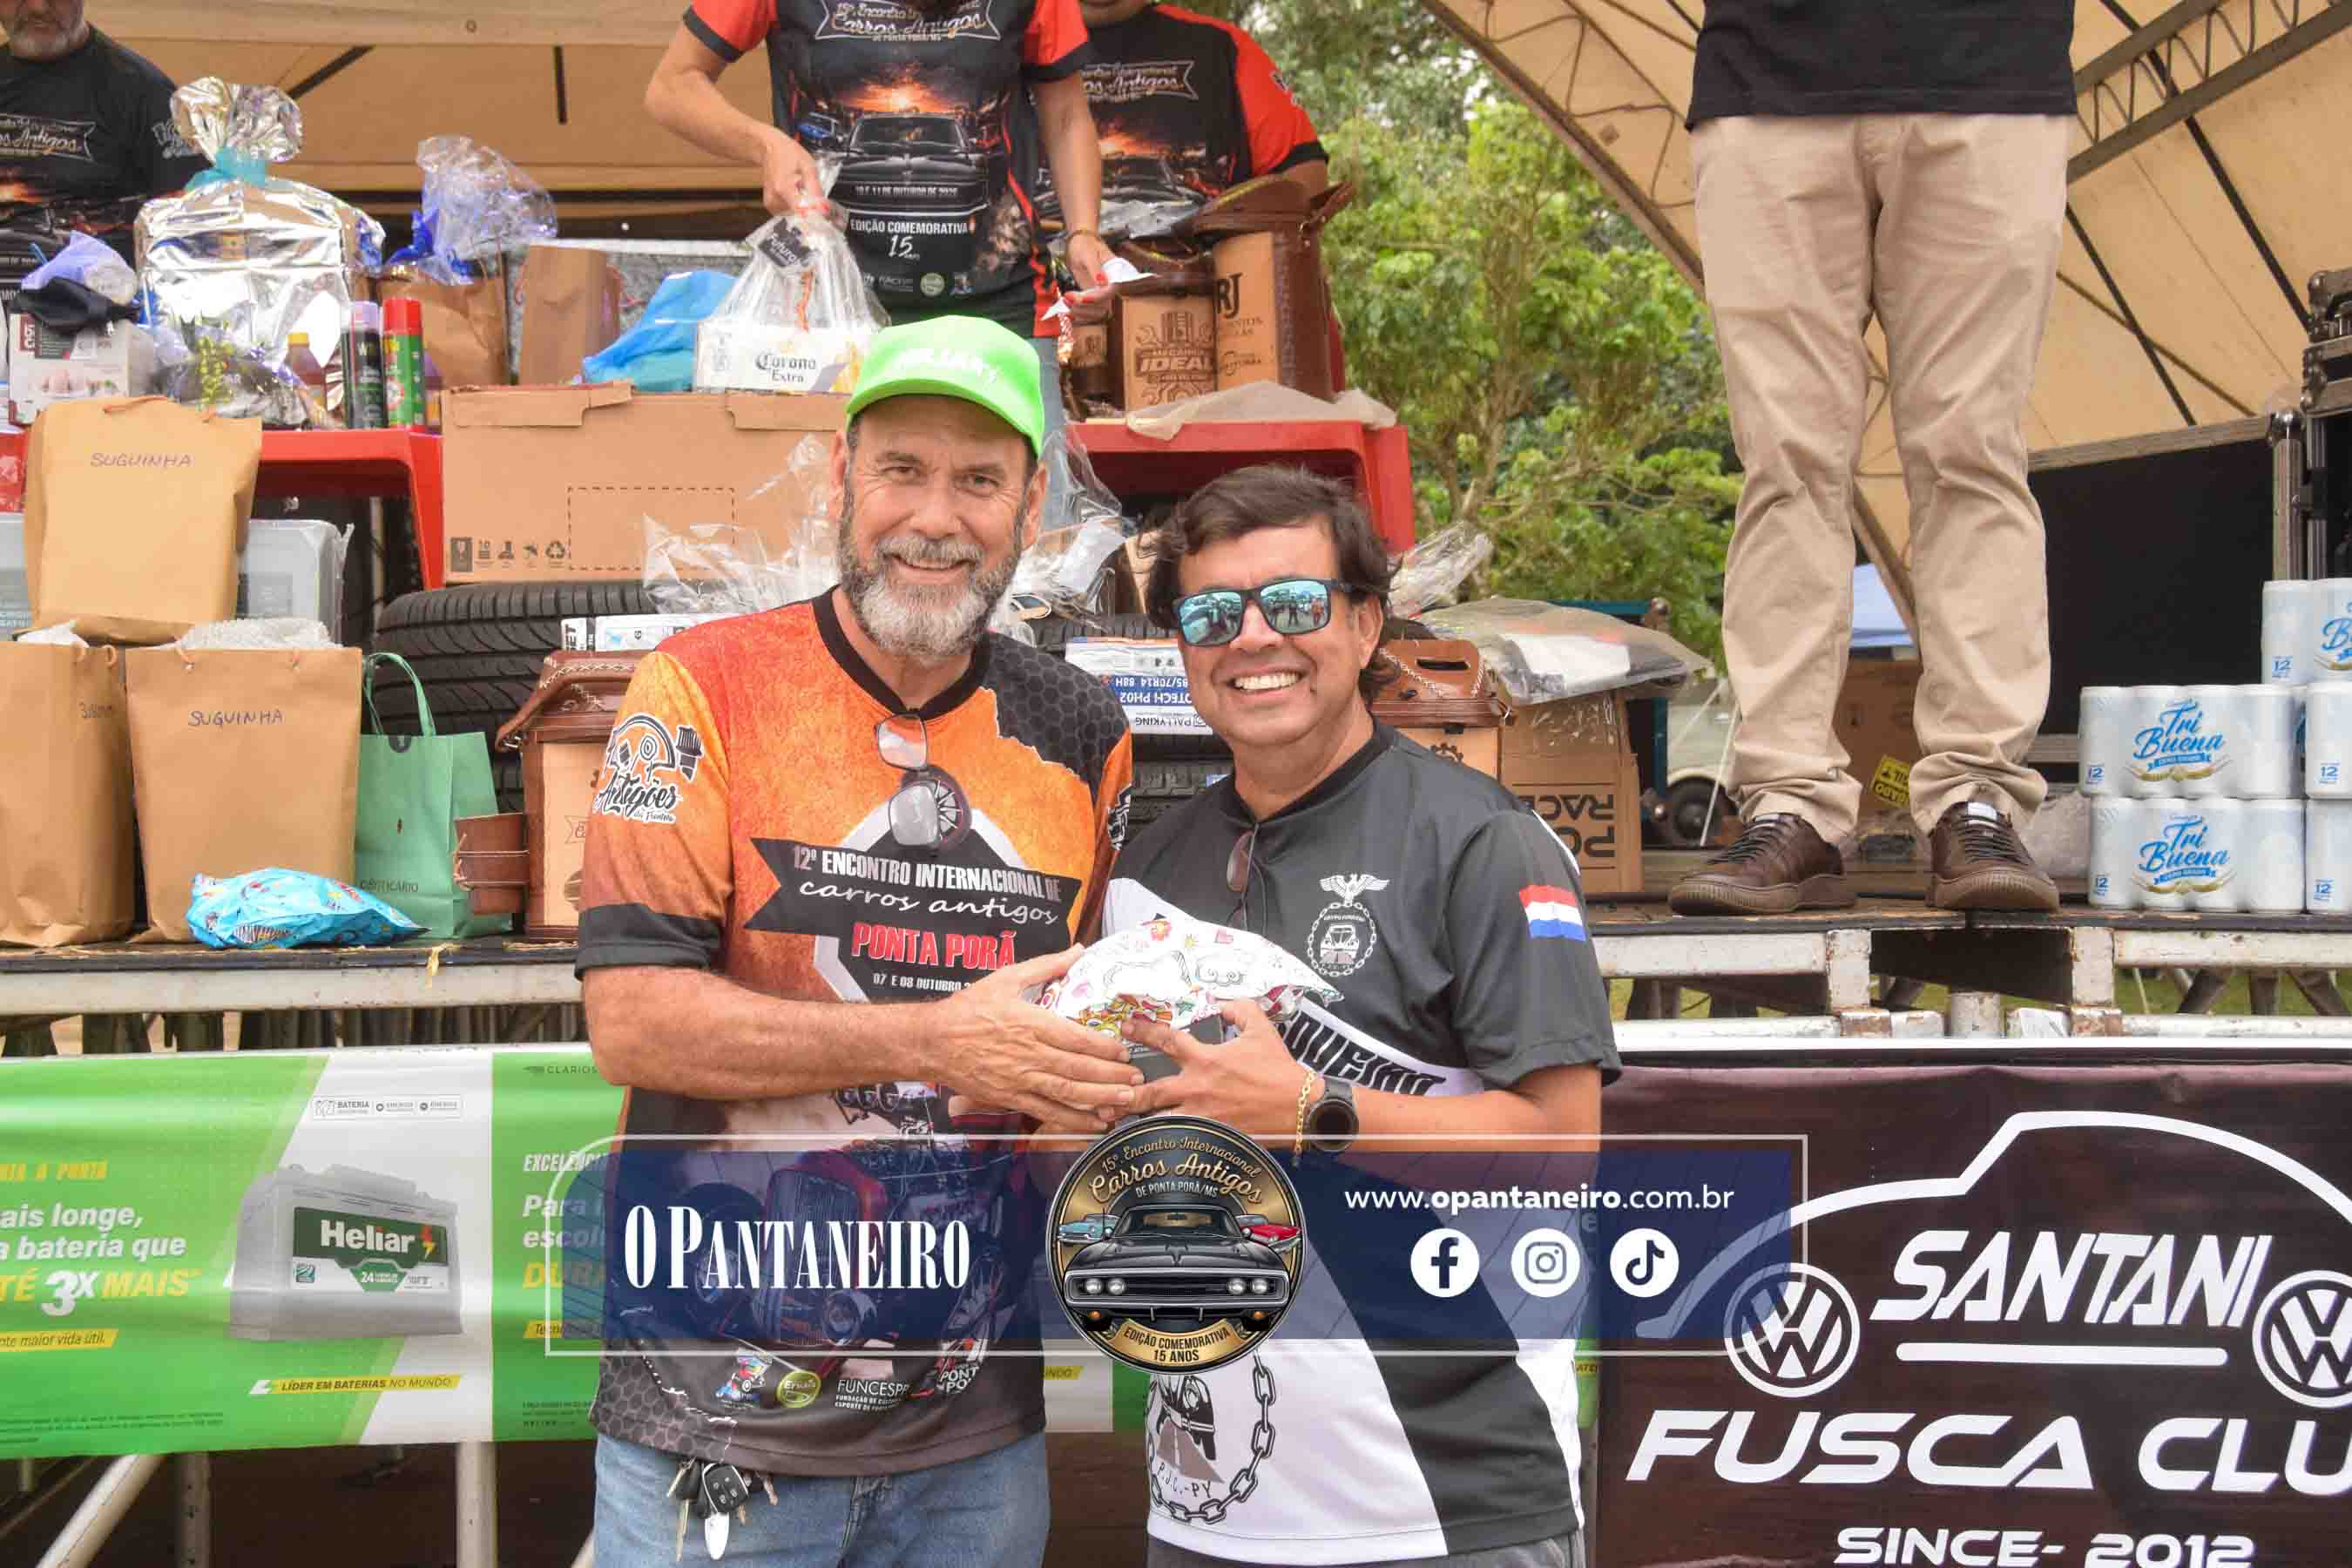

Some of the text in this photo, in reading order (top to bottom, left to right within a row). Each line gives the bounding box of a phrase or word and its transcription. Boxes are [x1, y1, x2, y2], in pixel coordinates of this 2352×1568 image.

[850, 219, 969, 235] EDIÇÃO COMEMORATIVA
[888, 234, 914, 258] 15
[755, 352, 817, 370] Corona
[770, 369, 805, 383] Extra
[90, 451, 193, 470] SUGUINHA
[187, 709, 284, 727] SUGUINHA
[2159, 700, 2203, 737] Tri
[2133, 727, 2226, 760] Buena
[2321, 765, 2339, 778] 12
[2163, 819, 2208, 852] Tri
[2139, 841, 2231, 873] Buena
[821, 849, 910, 887] ENCONTRO
[915, 862, 1045, 899] INTERNACIONAL
[2315, 883, 2332, 895] 12
[799, 880, 1059, 925] carros antigos
[850, 922, 1018, 970] PONTA PORÃ
[891, 975, 898, 987] E
[916, 976, 962, 990] OUTUBRO
[51, 1201, 144, 1233] longe,
[523, 1194, 586, 1218] Para
[16, 1231, 125, 1260] bateria
[132, 1236, 187, 1262] que
[320, 1219, 416, 1254] Heliar
[1869, 1229, 2273, 1328] SANTANI
[20, 1334, 56, 1347] maior
[57, 1331, 82, 1346] vida
[281, 1378, 452, 1392] LÍDER EM BATERIAS NO MUNDO
[835, 1395, 868, 1405] FUNDAÇÃO
[835, 1401, 862, 1411] ESPORTE
[1625, 1409, 2352, 1497] FUSCA CLU
[2085, 1533, 2256, 1568] 2012
